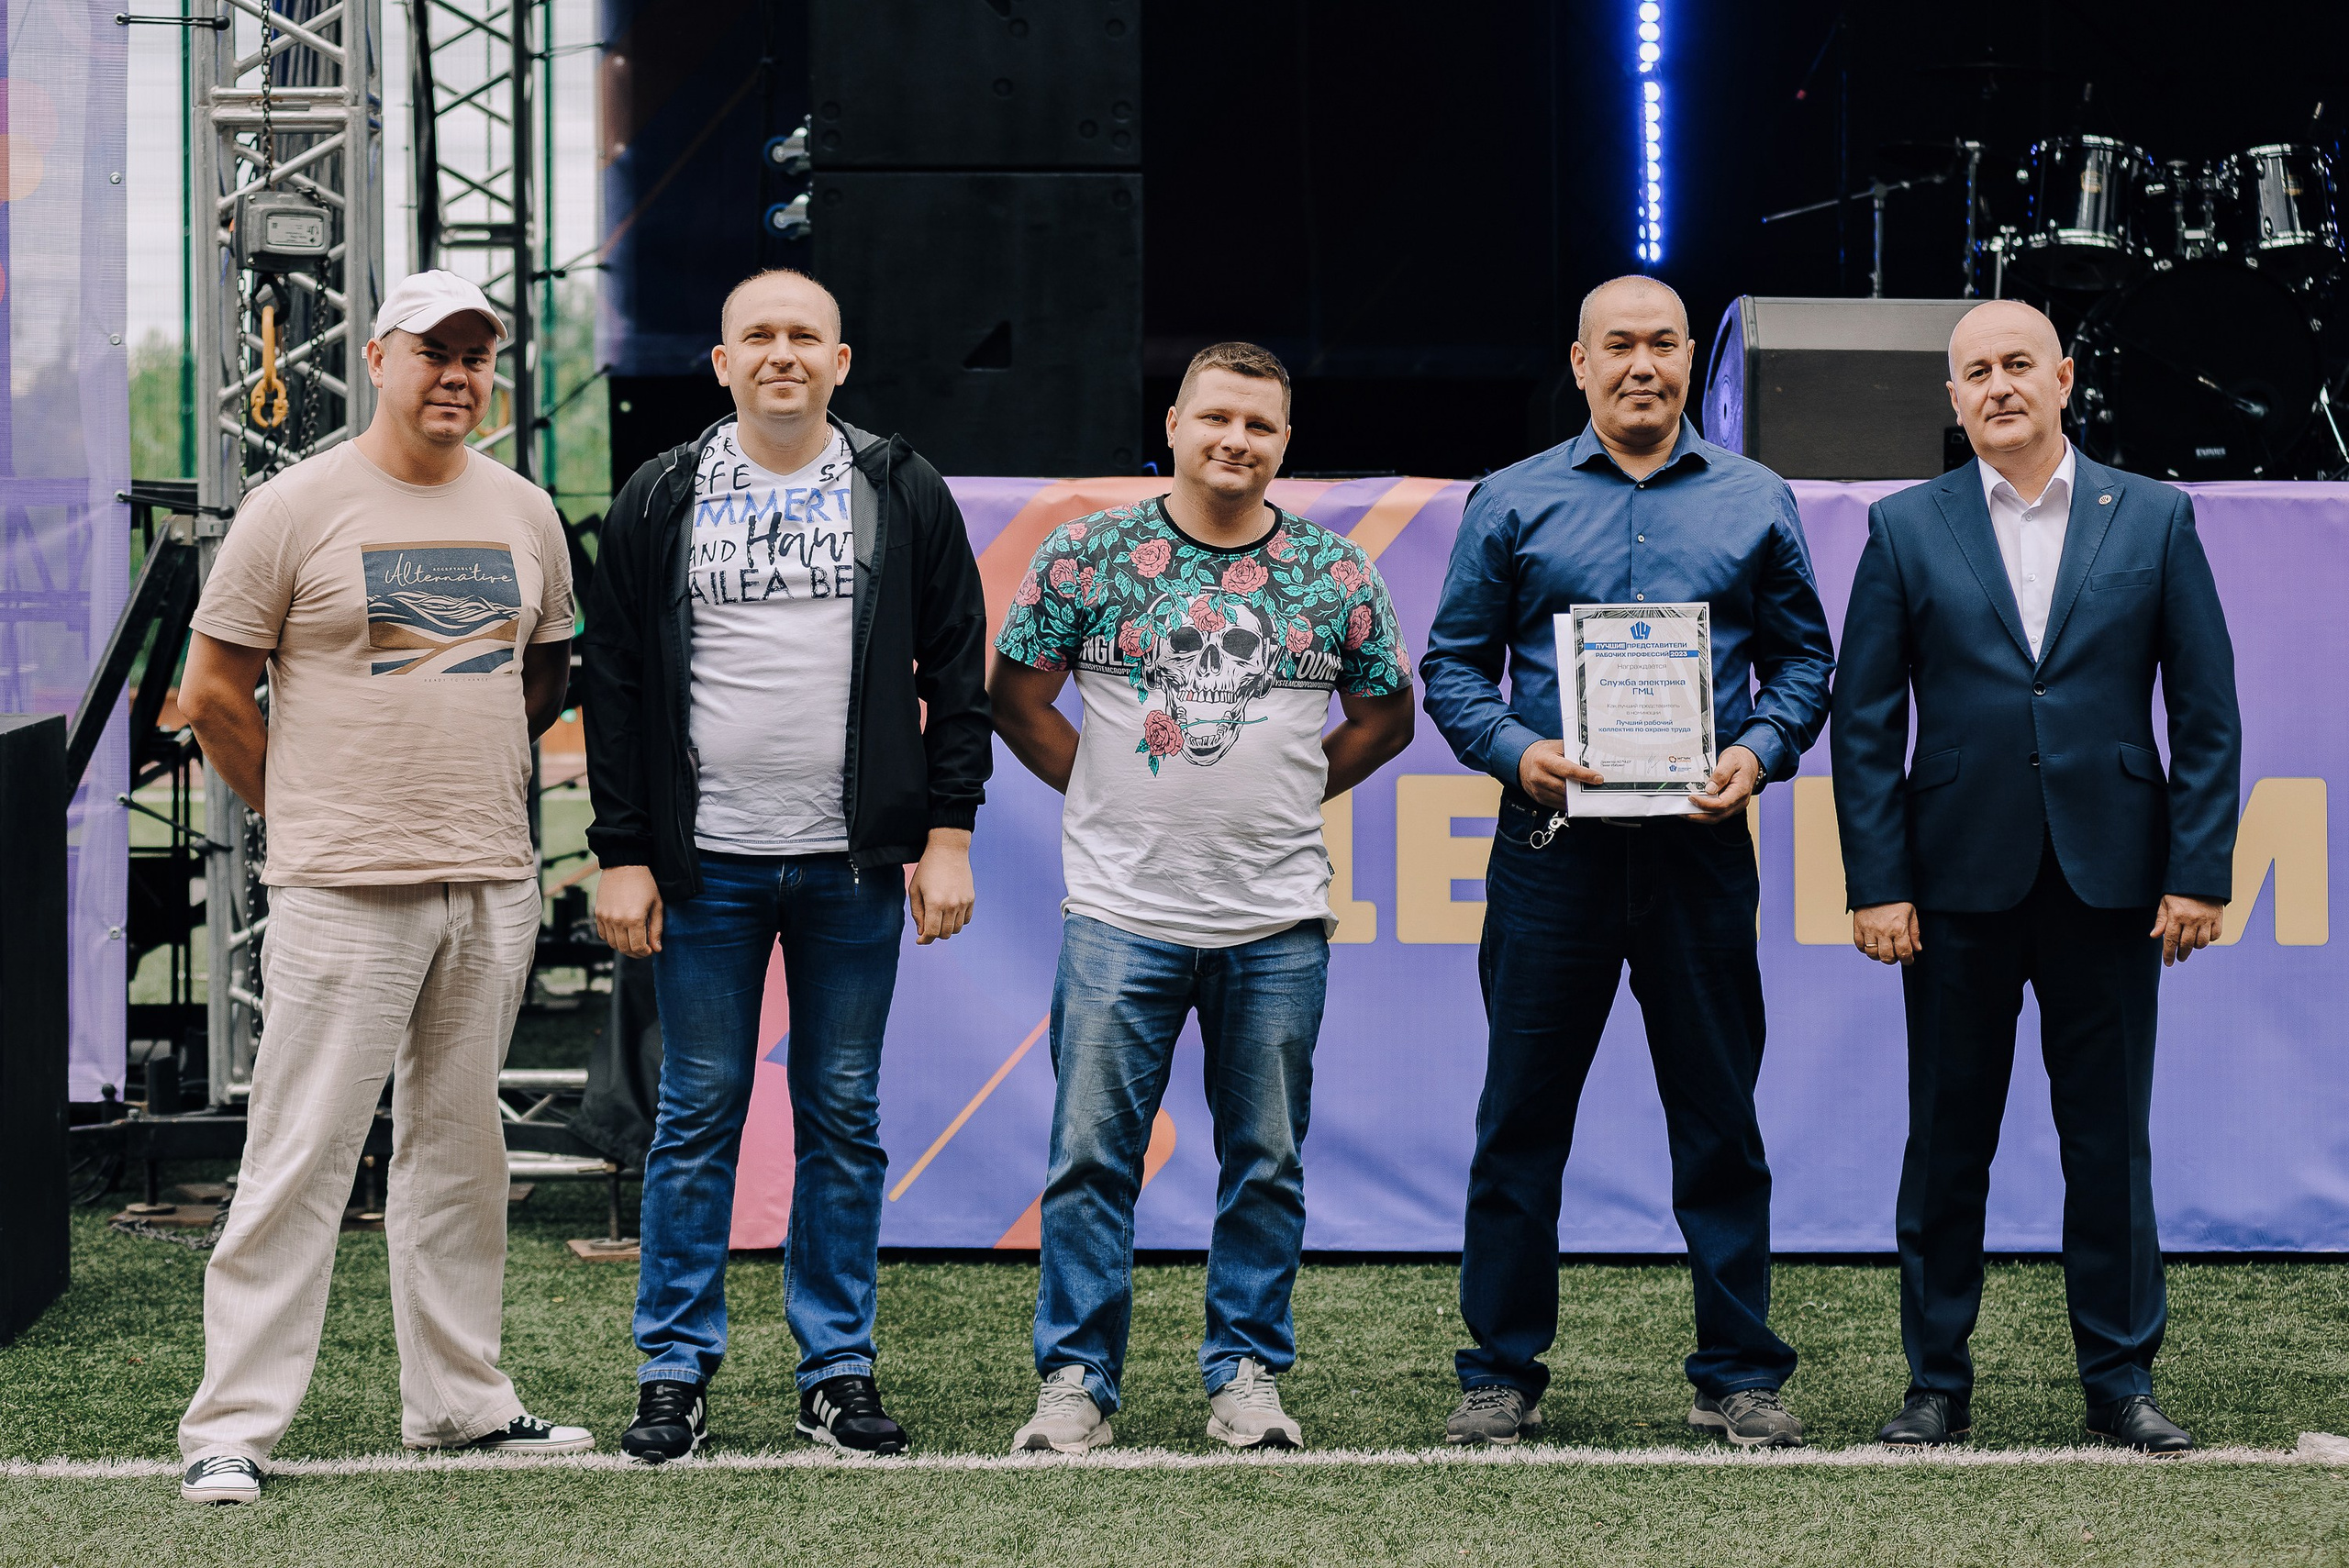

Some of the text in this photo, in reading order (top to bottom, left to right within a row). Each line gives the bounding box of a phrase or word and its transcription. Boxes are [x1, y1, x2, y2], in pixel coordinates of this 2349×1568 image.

[384, 552, 513, 587] Alternative
[1599, 678, 1687, 687] Служба электрика
[1632, 687, 1654, 696] ГМЦ
